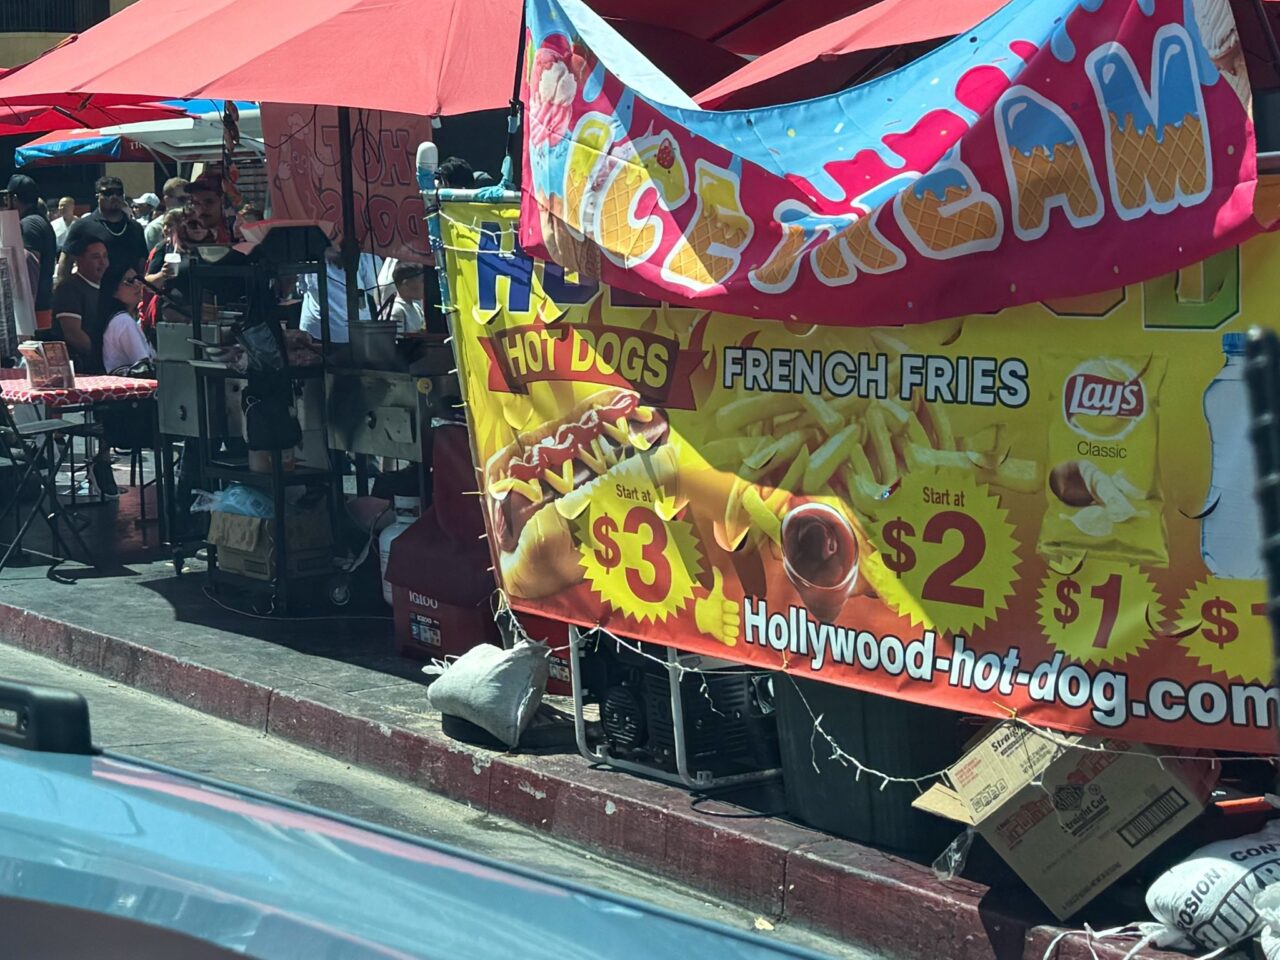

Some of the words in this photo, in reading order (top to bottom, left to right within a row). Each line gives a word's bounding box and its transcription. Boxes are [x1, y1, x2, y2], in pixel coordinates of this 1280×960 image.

[563, 113, 755, 292] ICE
[503, 329, 562, 378] HOT
[570, 329, 669, 388] DOGS
[723, 346, 888, 399] FRENCH
[899, 353, 1030, 408] FRIES
[1069, 375, 1139, 416] Lay's
[1077, 440, 1127, 459] Classic
[616, 484, 640, 501] Start
[642, 489, 652, 503] at
[923, 486, 950, 505] Start
[954, 490, 965, 507] at
[592, 506, 672, 603] $3
[881, 510, 986, 608] $2
[1053, 573, 1123, 649] $1
[743, 595, 1280, 728] Hollywood-hot-dog.com
